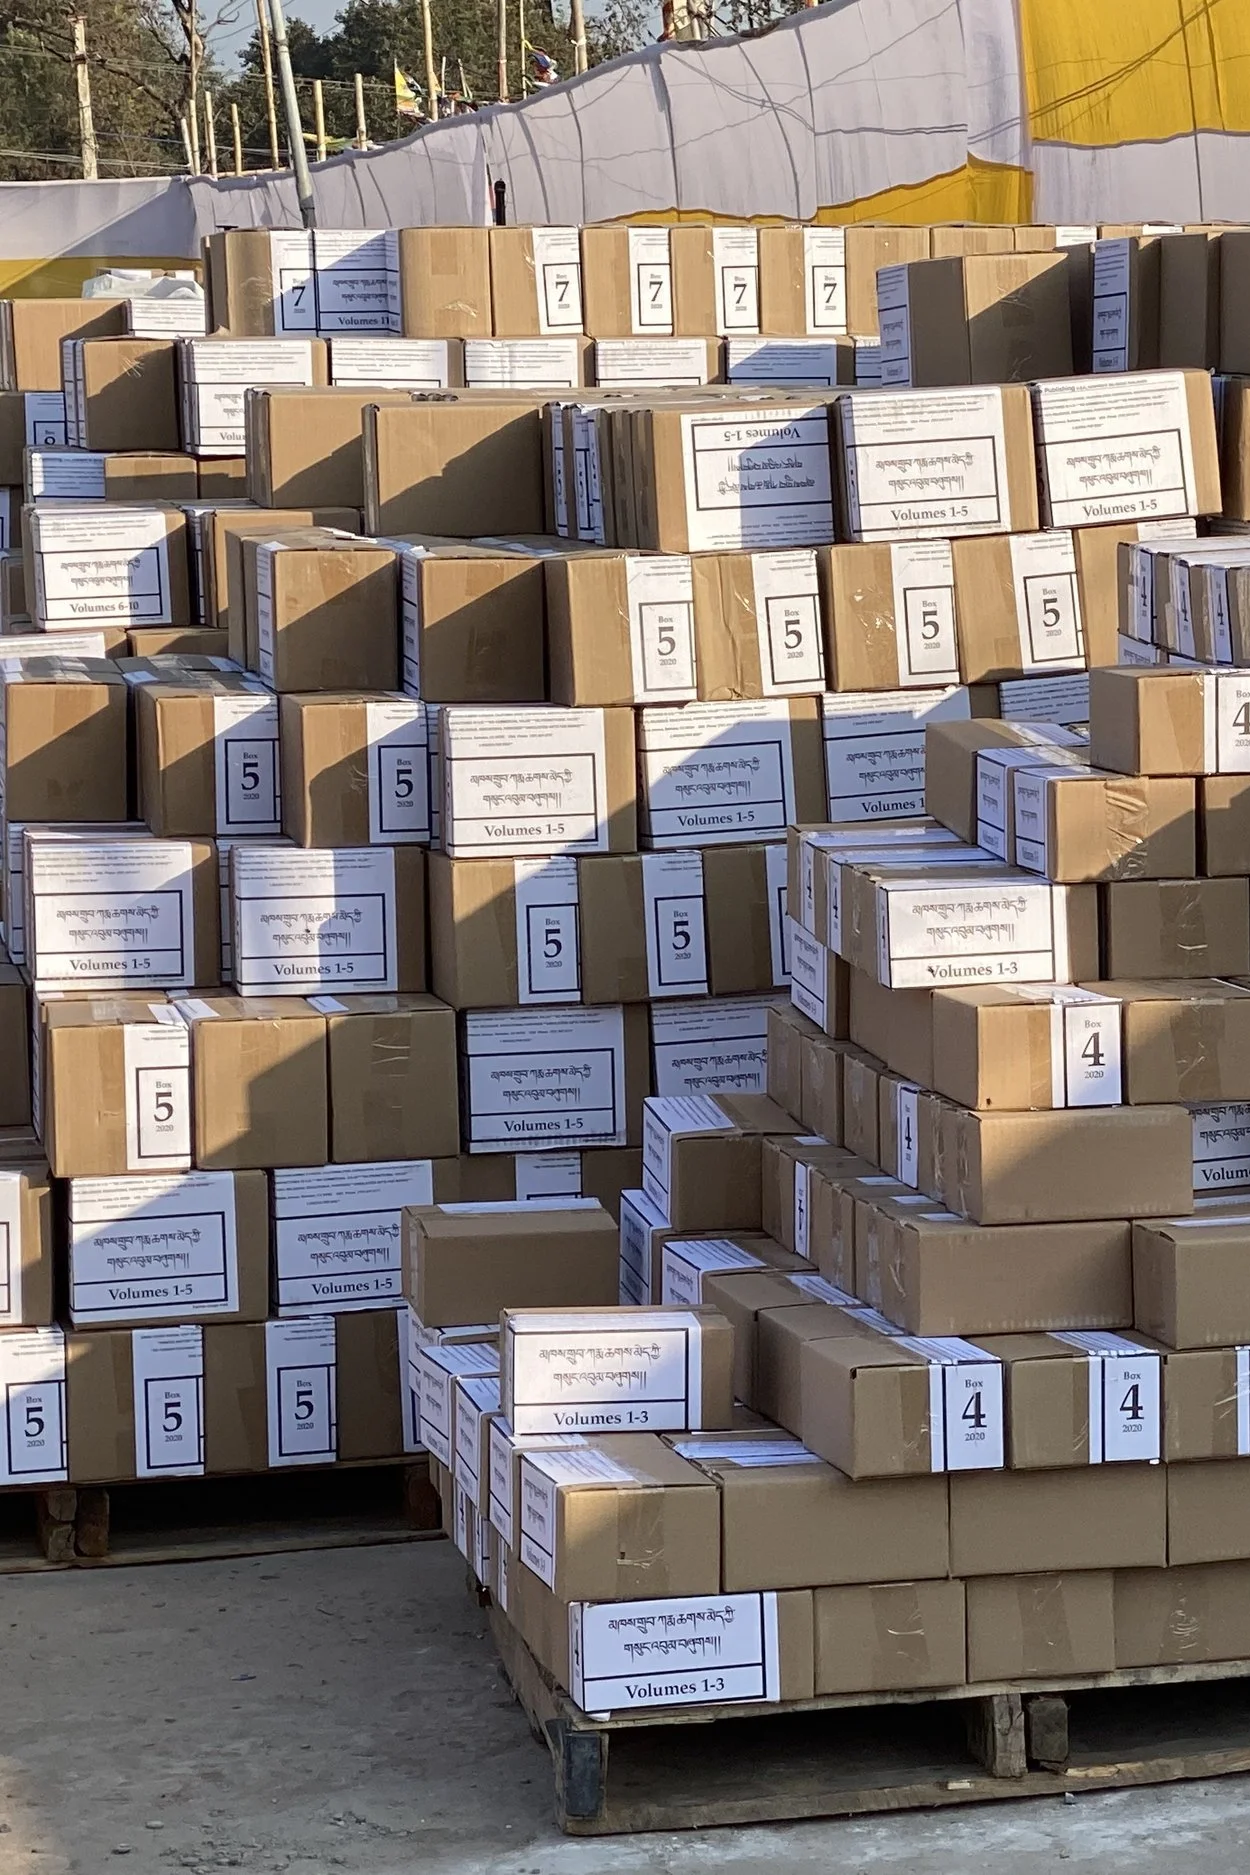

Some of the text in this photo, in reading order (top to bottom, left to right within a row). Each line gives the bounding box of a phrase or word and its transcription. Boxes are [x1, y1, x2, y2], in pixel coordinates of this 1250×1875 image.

[291, 285, 306, 307] 7
[555, 281, 570, 302] 7
[649, 281, 663, 302] 7
[733, 283, 747, 304] 7
[823, 283, 837, 304] 7
[337, 315, 378, 327] Volumes
[724, 427, 801, 442] Volumes 1-5
[890, 506, 968, 521] Volumes 1-5
[1082, 499, 1157, 517] Volumes 1-5
[70, 603, 116, 613] Volumes
[1043, 597, 1060, 627] 5
[784, 619, 802, 649] 5
[921, 610, 939, 640] 5
[657, 626, 676, 656] 5
[241, 762, 259, 791] 5
[394, 769, 413, 798] 5
[861, 800, 916, 814] Volumes
[677, 810, 755, 826] Volumes 1-5
[484, 823, 565, 837] Volumes 1-5
[543, 928, 562, 958] 5
[672, 920, 691, 950] 5
[69, 958, 151, 971] Volumes 1-5
[273, 962, 354, 975] Volumes 1-5
[926, 961, 1018, 978] Volumes 1-3
[1084, 1019, 1102, 1029] Box
[1081, 1032, 1106, 1067] 4
[1084, 1070, 1104, 1079] 2020
[153, 1091, 174, 1122] 5
[503, 1117, 583, 1132] Volumes 1-5
[108, 1284, 193, 1300] Volumes 1-5
[311, 1278, 393, 1295] Volumes 1-5
[965, 1379, 983, 1388] Box
[294, 1389, 314, 1420] 5
[962, 1391, 988, 1429] 4
[1119, 1384, 1145, 1420] 4
[24, 1406, 44, 1437] 5
[162, 1401, 182, 1432] 5
[553, 1410, 649, 1426] Volumes 1-3
[964, 1429, 985, 1442] 2020
[624, 1677, 724, 1699] Volumes 1-3
